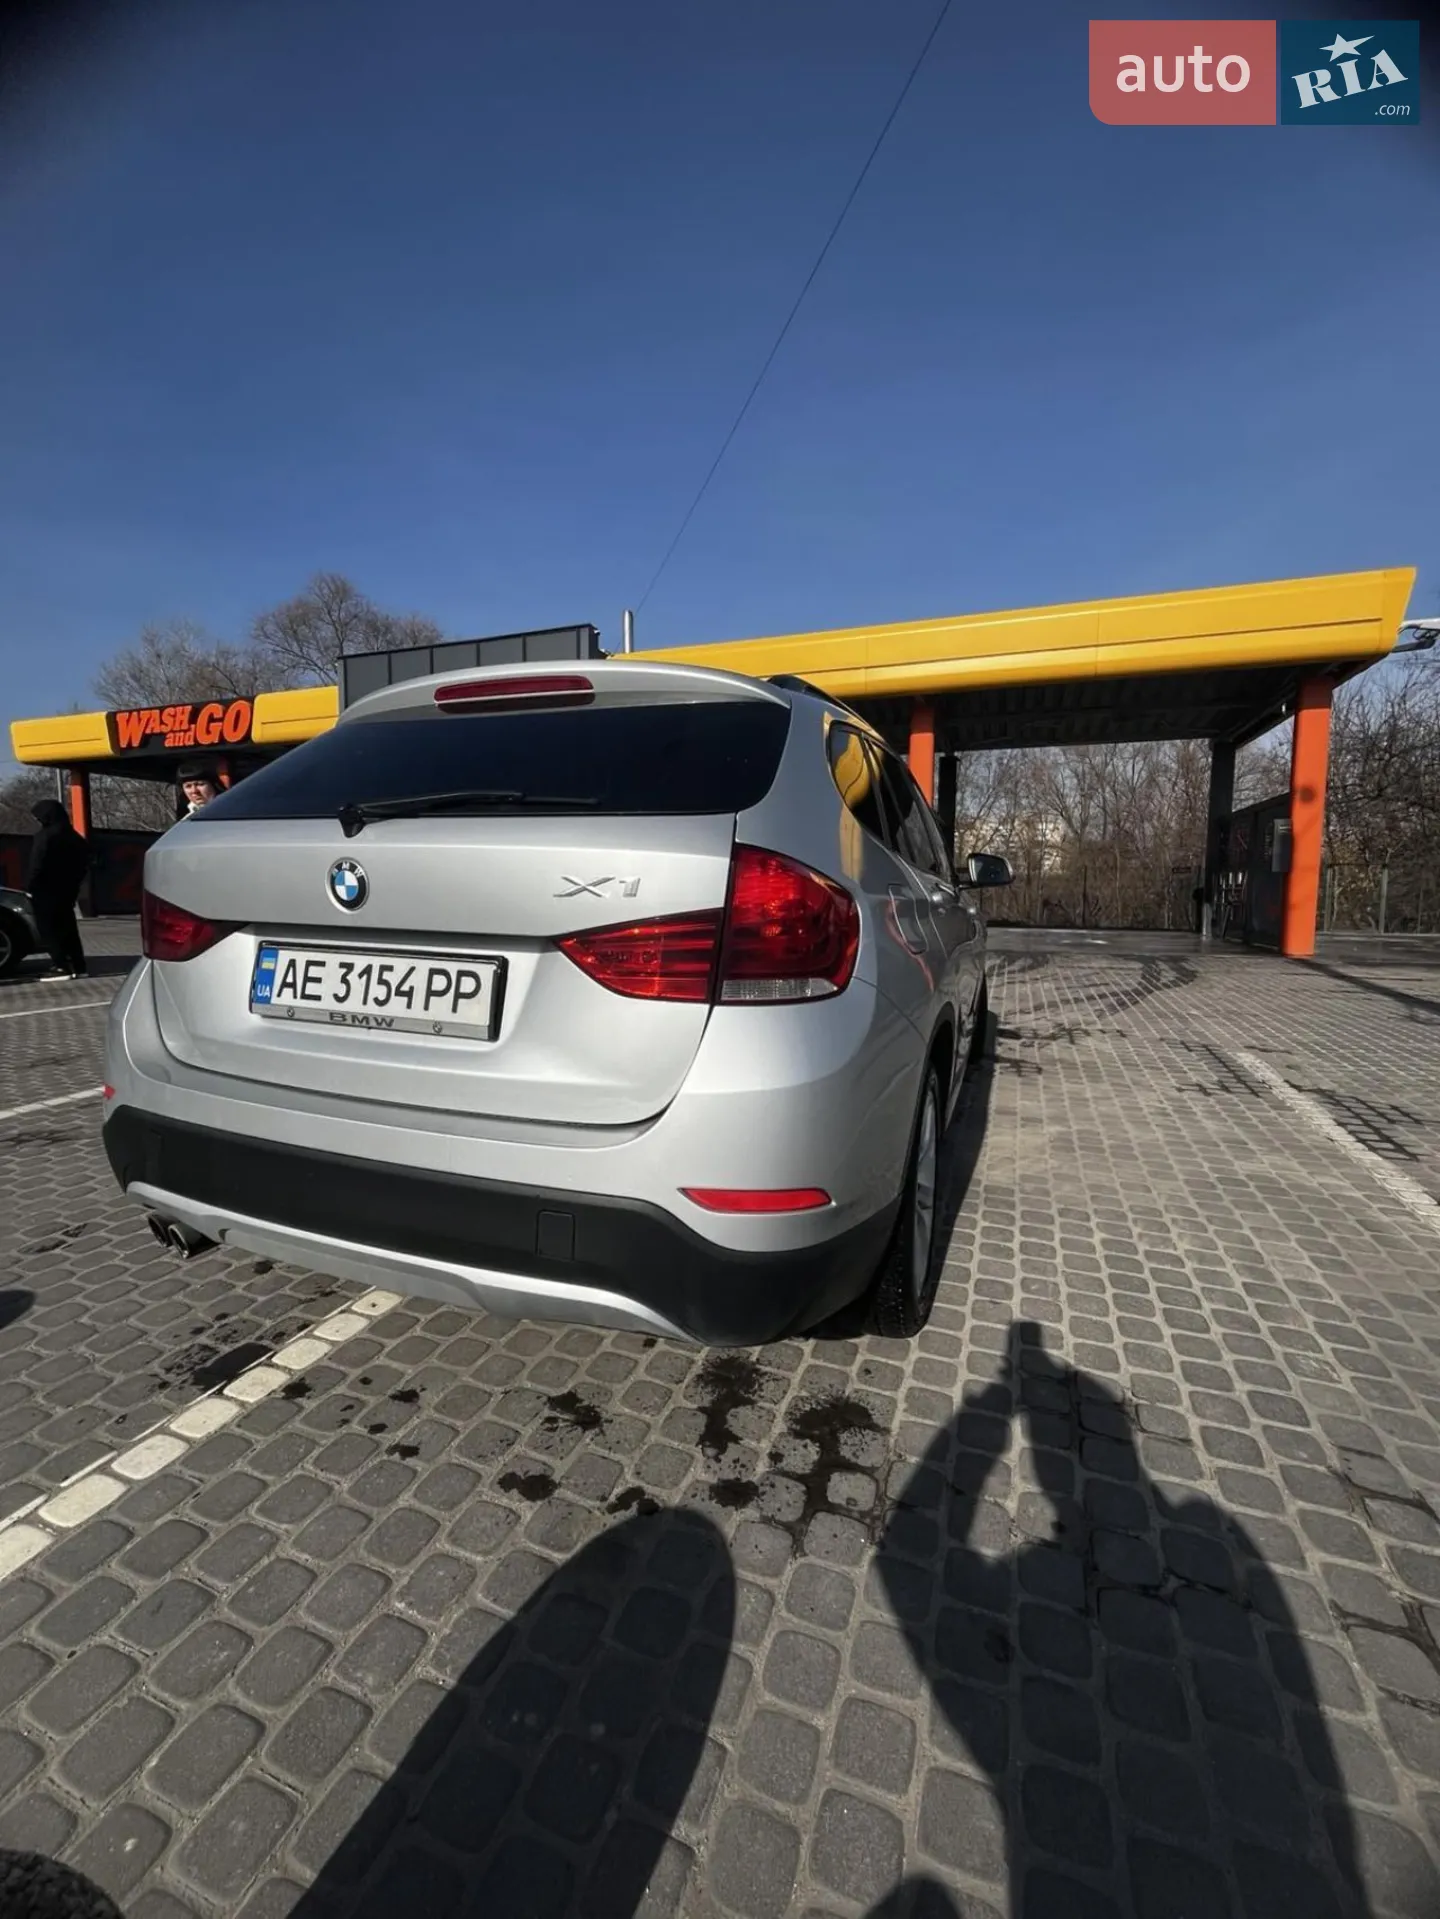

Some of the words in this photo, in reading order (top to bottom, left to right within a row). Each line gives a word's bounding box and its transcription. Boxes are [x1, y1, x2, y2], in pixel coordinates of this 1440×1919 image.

[116, 705, 193, 748] WASH
[164, 723, 196, 748] and
[196, 700, 252, 745] GO
[552, 875, 641, 898] X1
[256, 983, 271, 998] UA
[276, 957, 326, 1002] AE
[332, 960, 417, 1010] 3154
[423, 967, 482, 1014] PP
[328, 1011, 395, 1028] BMW
